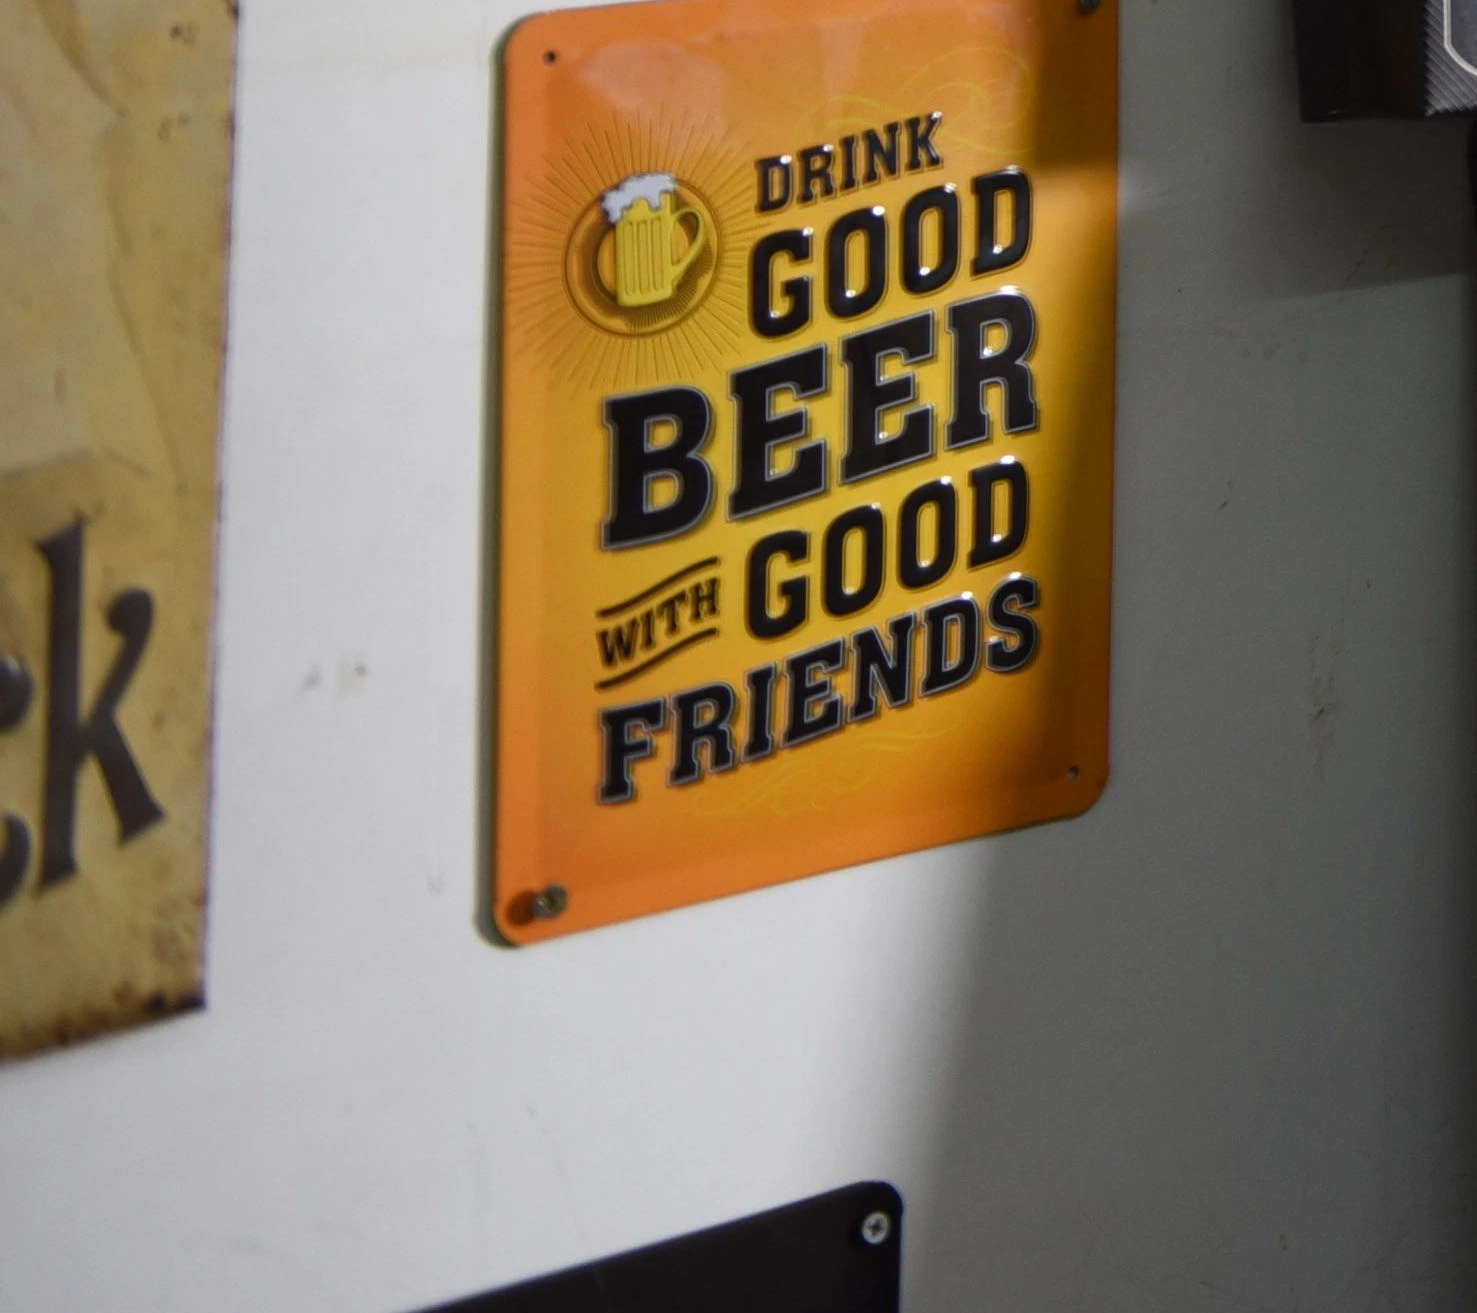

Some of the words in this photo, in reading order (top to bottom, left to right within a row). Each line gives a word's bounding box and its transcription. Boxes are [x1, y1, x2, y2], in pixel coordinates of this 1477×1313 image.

[748, 166, 1033, 340] GOOD
[754, 112, 944, 214] DRINK
[600, 284, 1040, 551] BEER
[596, 577, 721, 668] WITH
[744, 454, 1030, 641] GOOD
[597, 571, 1041, 806] FRIENDS
